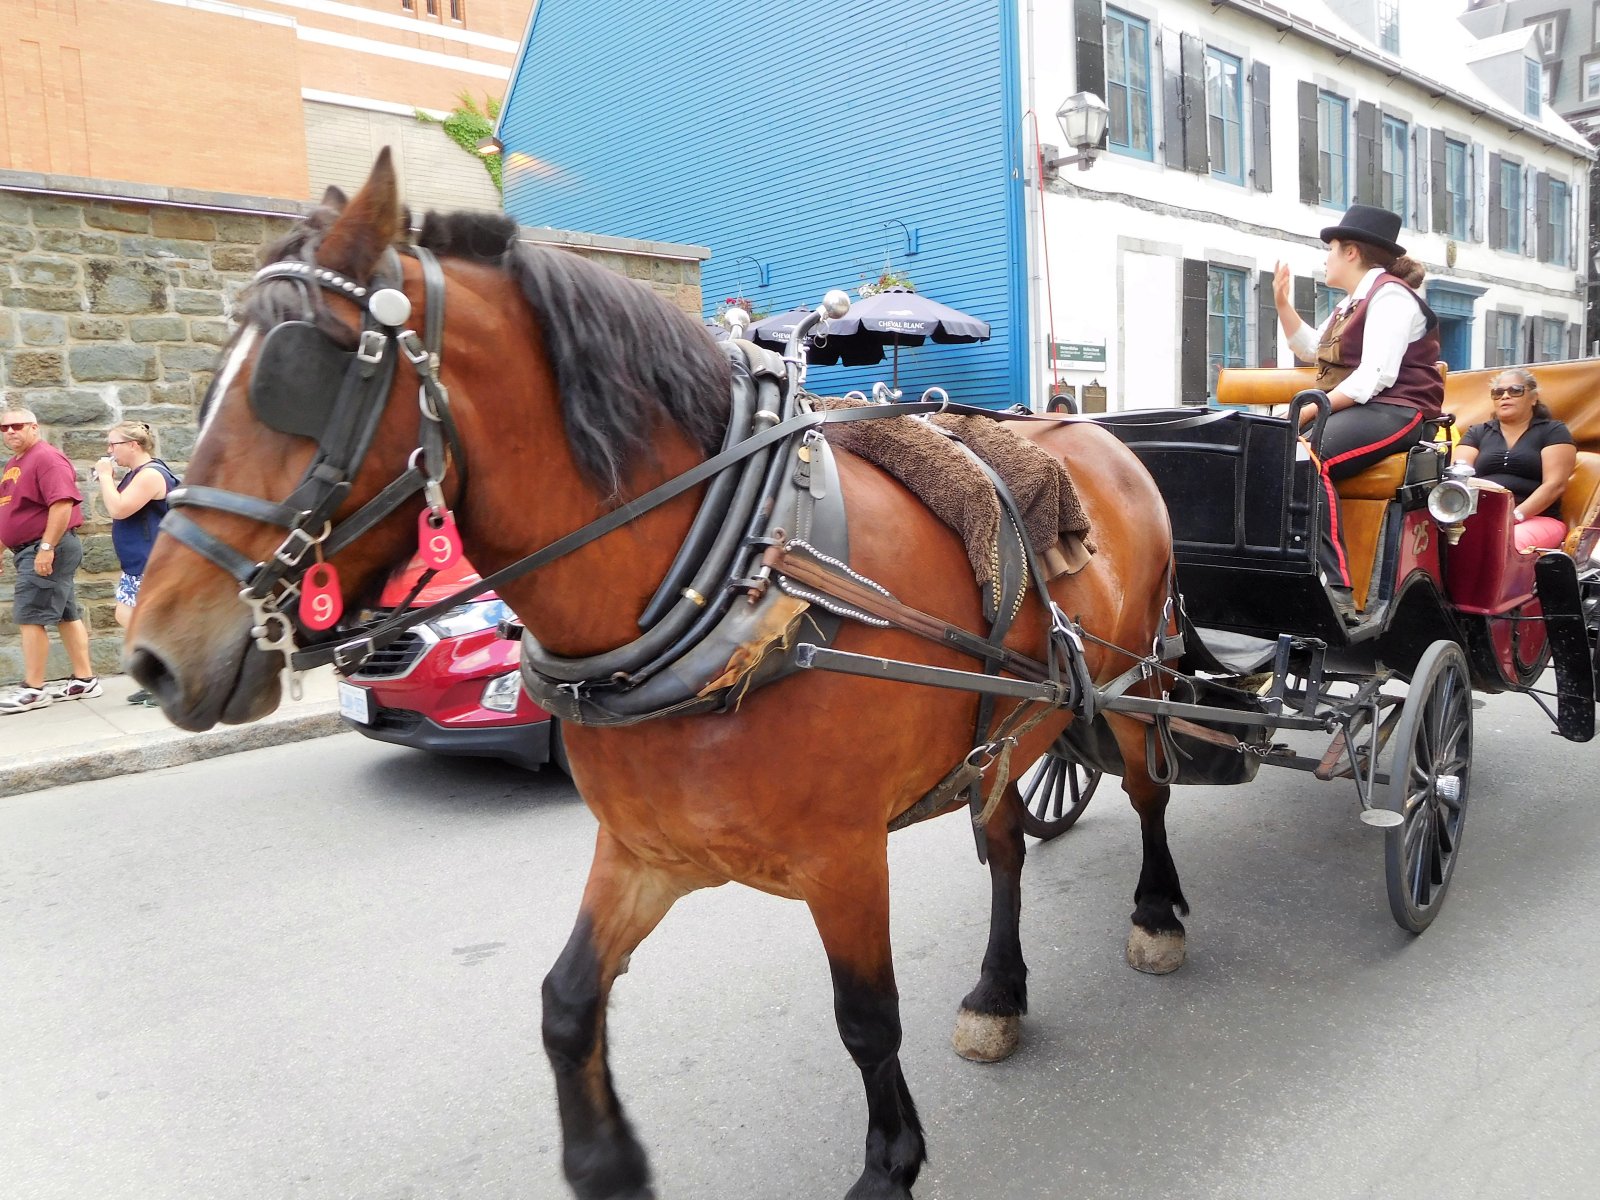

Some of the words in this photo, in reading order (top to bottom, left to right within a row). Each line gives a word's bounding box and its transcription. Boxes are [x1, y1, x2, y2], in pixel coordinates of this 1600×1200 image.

[878, 320, 902, 328] CHEVAL
[903, 321, 925, 329] BLANC
[429, 535, 452, 563] 9
[1413, 520, 1430, 555] 25
[311, 594, 334, 622] 9
